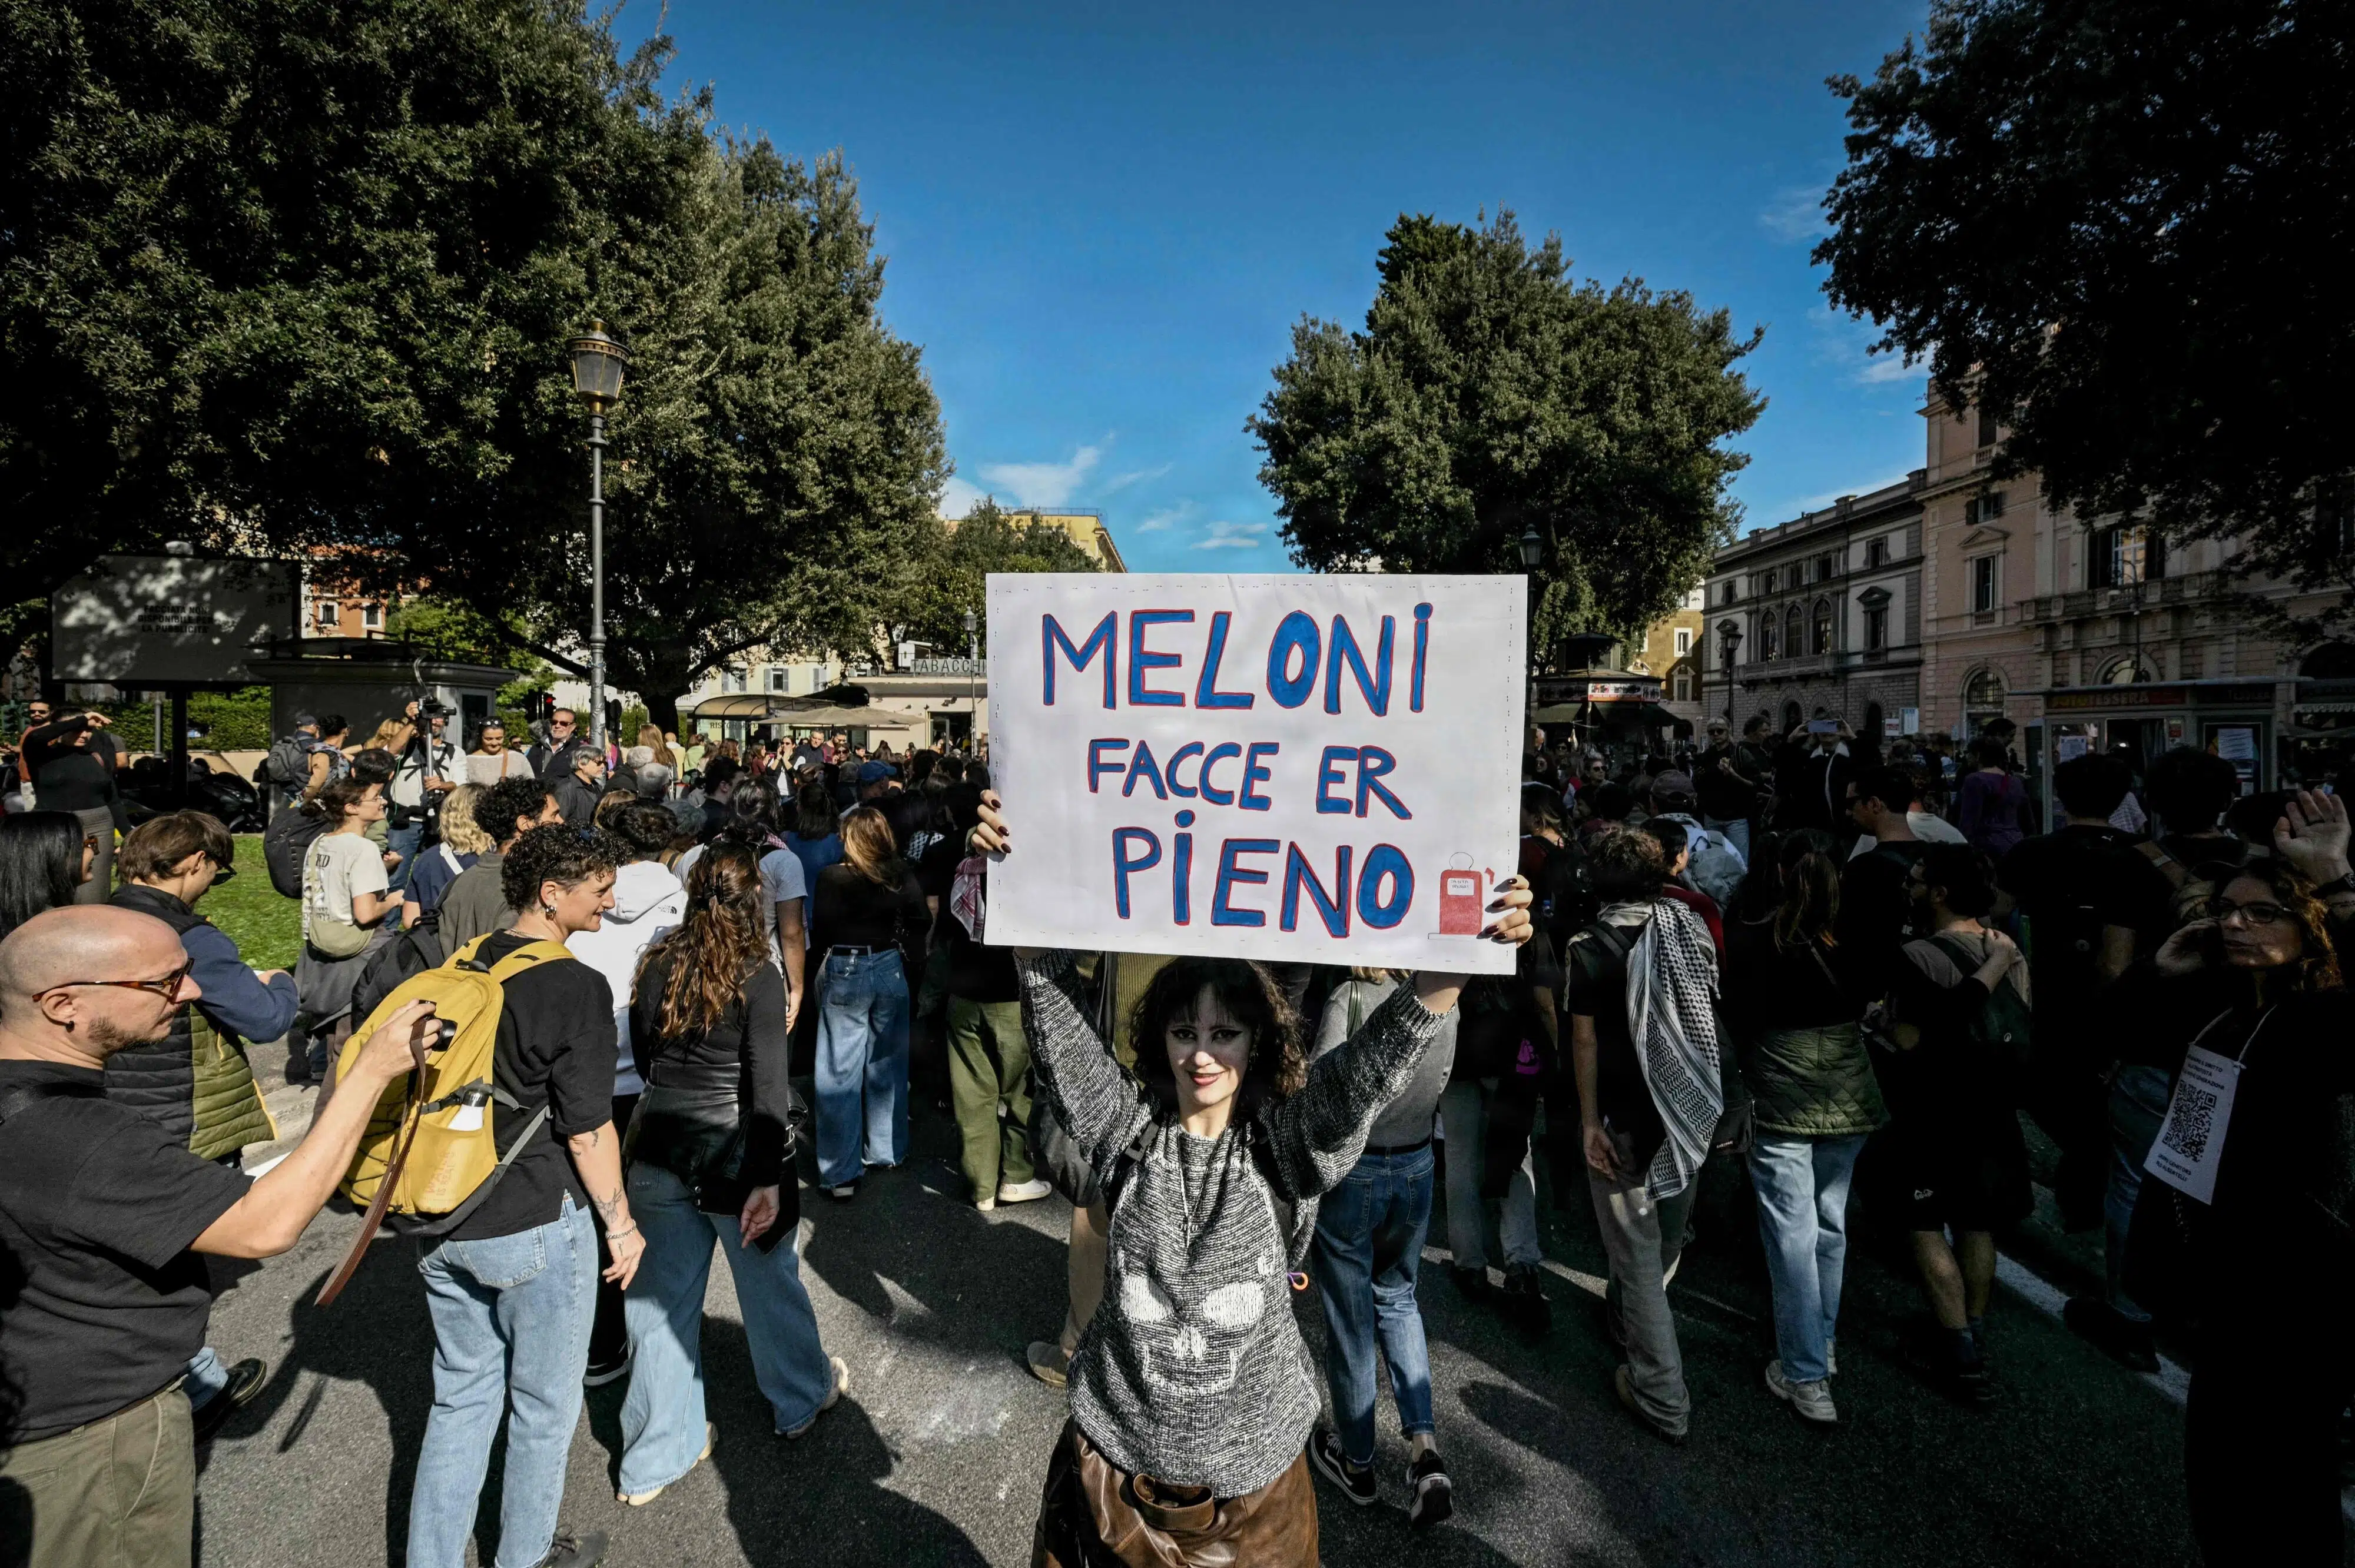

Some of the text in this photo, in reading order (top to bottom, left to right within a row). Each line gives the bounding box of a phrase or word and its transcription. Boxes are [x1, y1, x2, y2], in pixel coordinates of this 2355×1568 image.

[138, 615, 193, 623] DISPONIBILE
[911, 659, 985, 672] TABACCHI
[1087, 738, 1413, 820] FACCE ER
